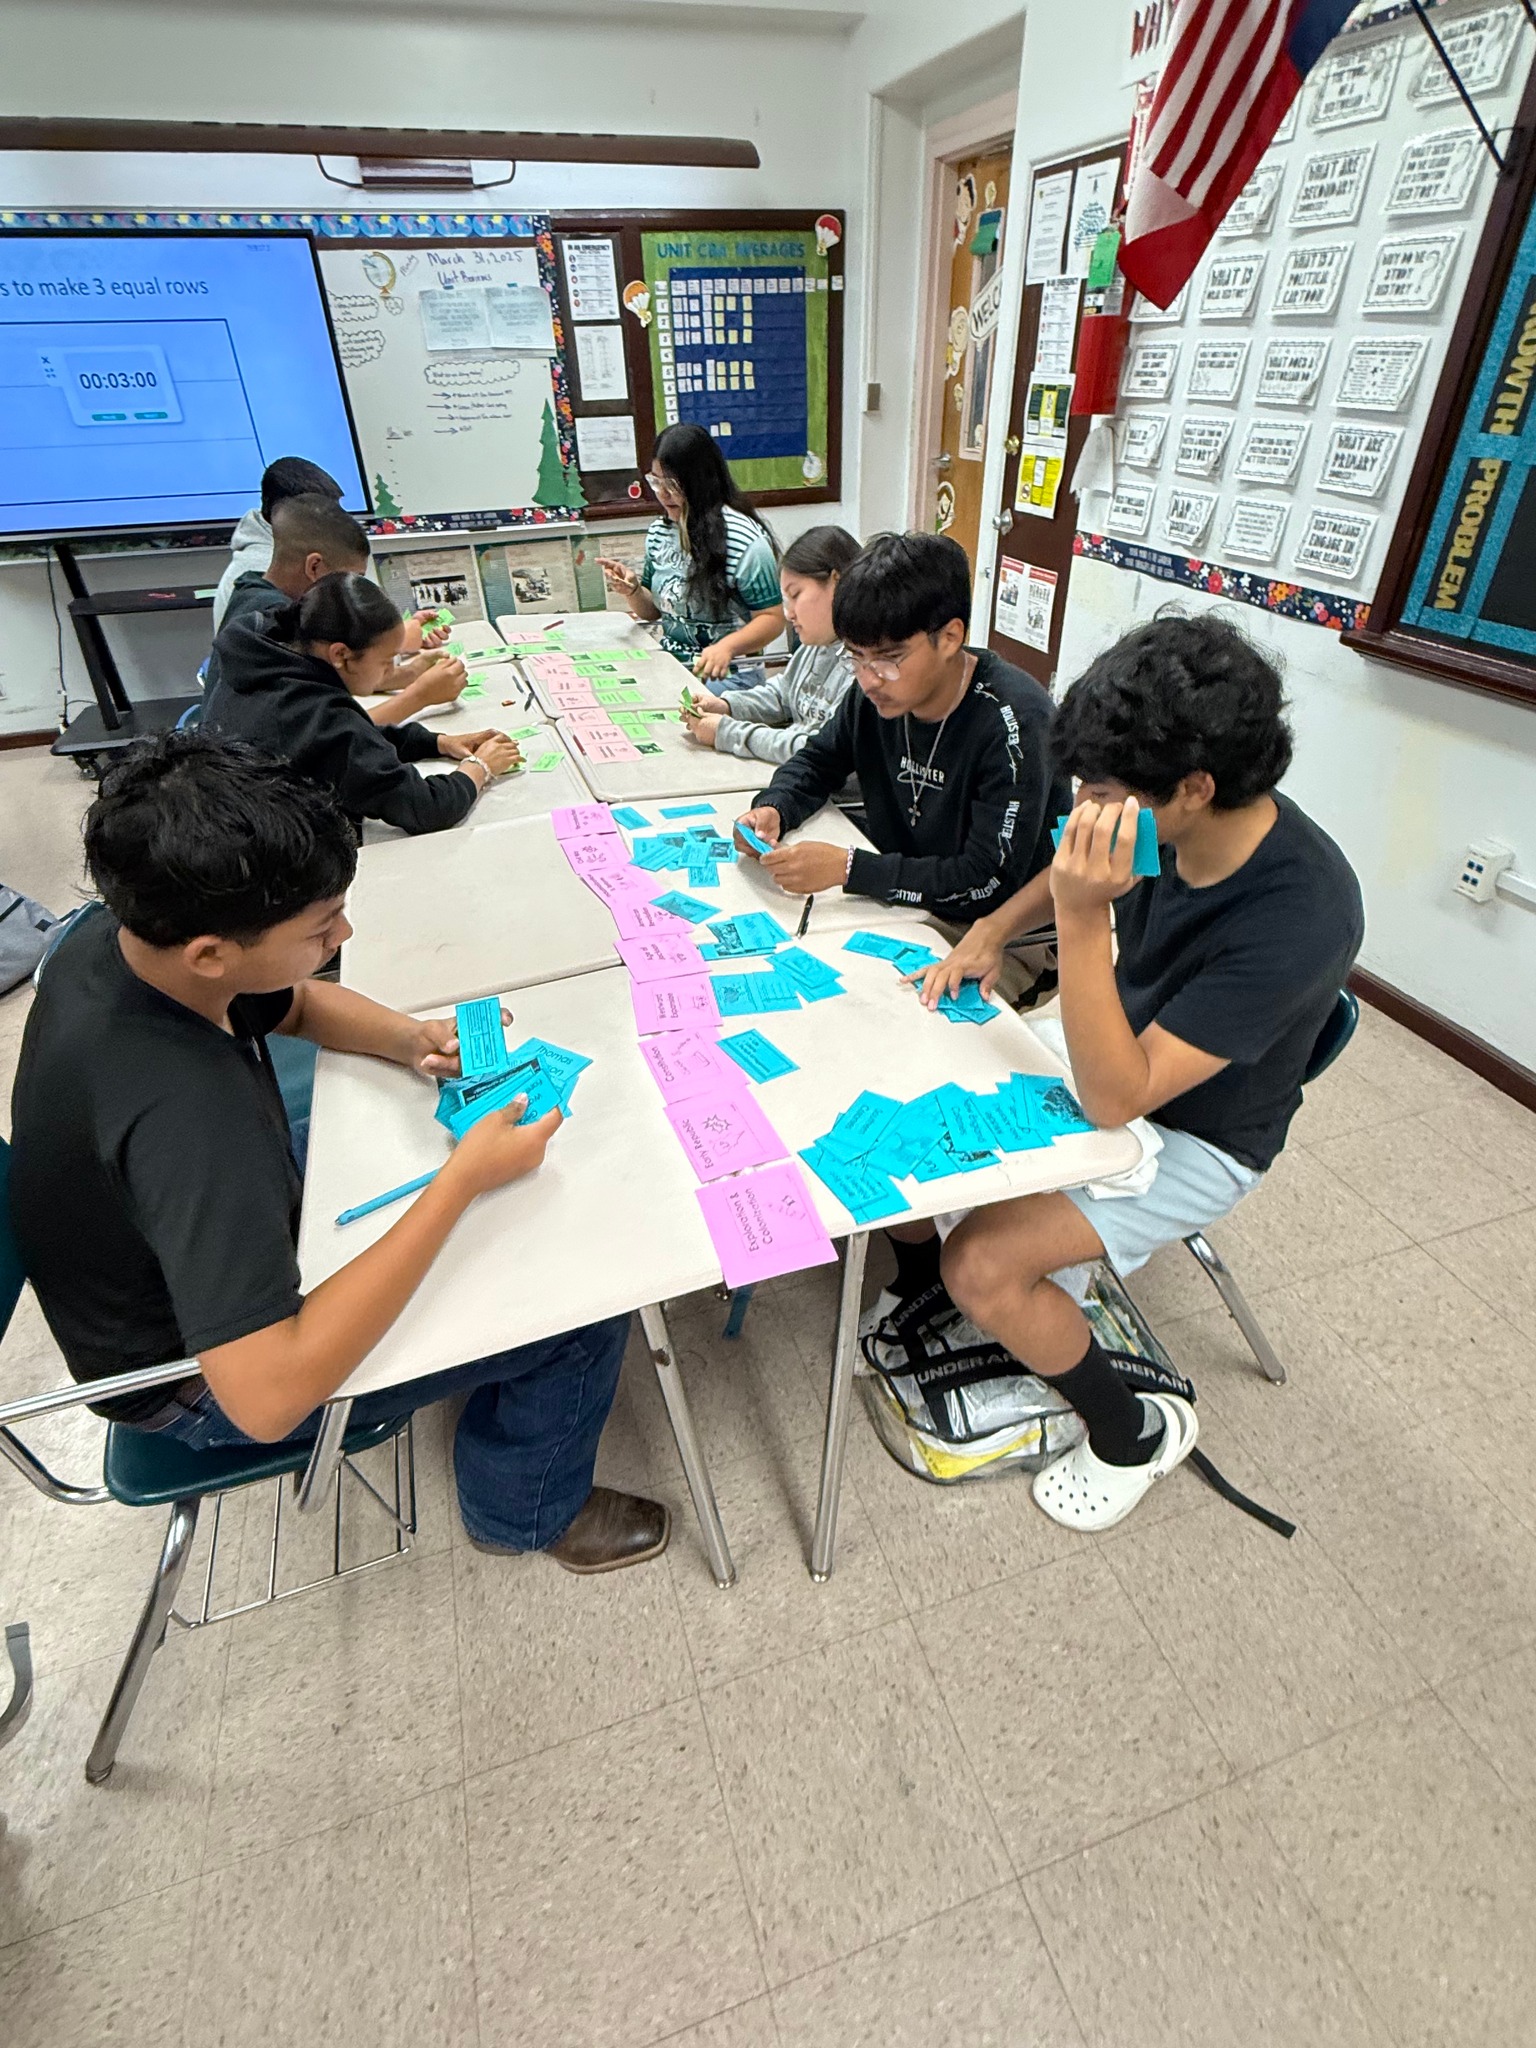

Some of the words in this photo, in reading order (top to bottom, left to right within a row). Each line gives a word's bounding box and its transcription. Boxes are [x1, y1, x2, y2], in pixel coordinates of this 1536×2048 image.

[1309, 159, 1339, 181] WHAT
[1339, 156, 1360, 177] ARE
[1302, 179, 1354, 200] SECONDARY
[427, 252, 465, 266] March
[657, 243, 691, 259] UNIT
[735, 242, 806, 258] AVERAGES
[12, 280, 34, 296] to
[39, 278, 89, 296] make
[93, 278, 106, 295] 3
[111, 277, 161, 299] equal
[166, 280, 209, 295] rows
[1211, 267, 1241, 287] WHAT
[1241, 267, 1253, 286] IS
[1283, 288, 1325, 303] CARTOON
[972, 285, 1001, 333] WELC
[1489, 302, 1536, 436] OWTH
[80, 372, 157, 389] 00:03:00
[1338, 434, 1365, 450] WHAT
[1364, 437, 1384, 452] ARE
[1332, 452, 1378, 472] PRIMARY
[1313, 519, 1361, 537] HISTORIANS
[1434, 458, 1502, 610] PROBLEM
[1309, 532, 1343, 552] ENGAGE
[1342, 539, 1356, 554] IN
[901, 756, 945, 783] HOLLISTER
[667, 993, 679, 1019] Expansion
[539, 1045, 574, 1066] Thomas
[652, 1046, 675, 1082] Constitution
[683, 1119, 703, 1150] Republic
[698, 1149, 714, 1168] Early
[730, 1192, 740, 1200] &
[735, 1200, 760, 1252] Exploration
[746, 1188, 773, 1245] Colonization
[917, 1354, 984, 1384] UNDER
